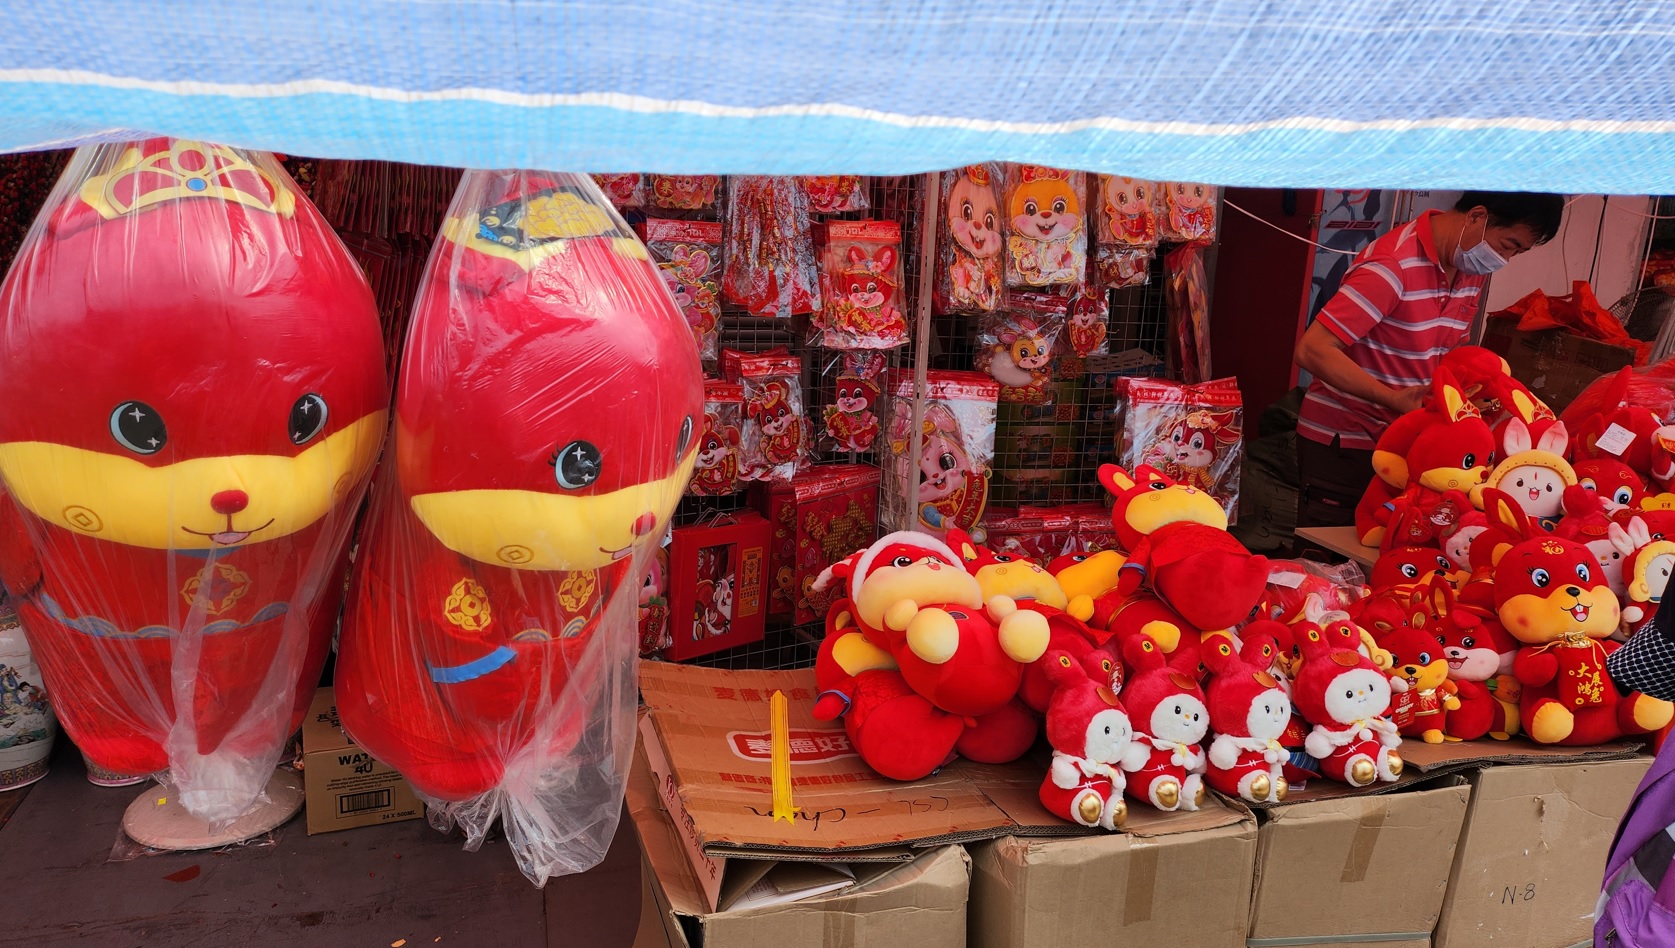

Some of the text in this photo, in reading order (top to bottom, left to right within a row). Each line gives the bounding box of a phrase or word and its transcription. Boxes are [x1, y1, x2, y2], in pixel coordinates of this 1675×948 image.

[962, 478, 983, 525] 兔年大吉
[354, 762, 373, 774] 4U
[397, 810, 416, 818] 500ML
[1501, 882, 1536, 905] N-8
